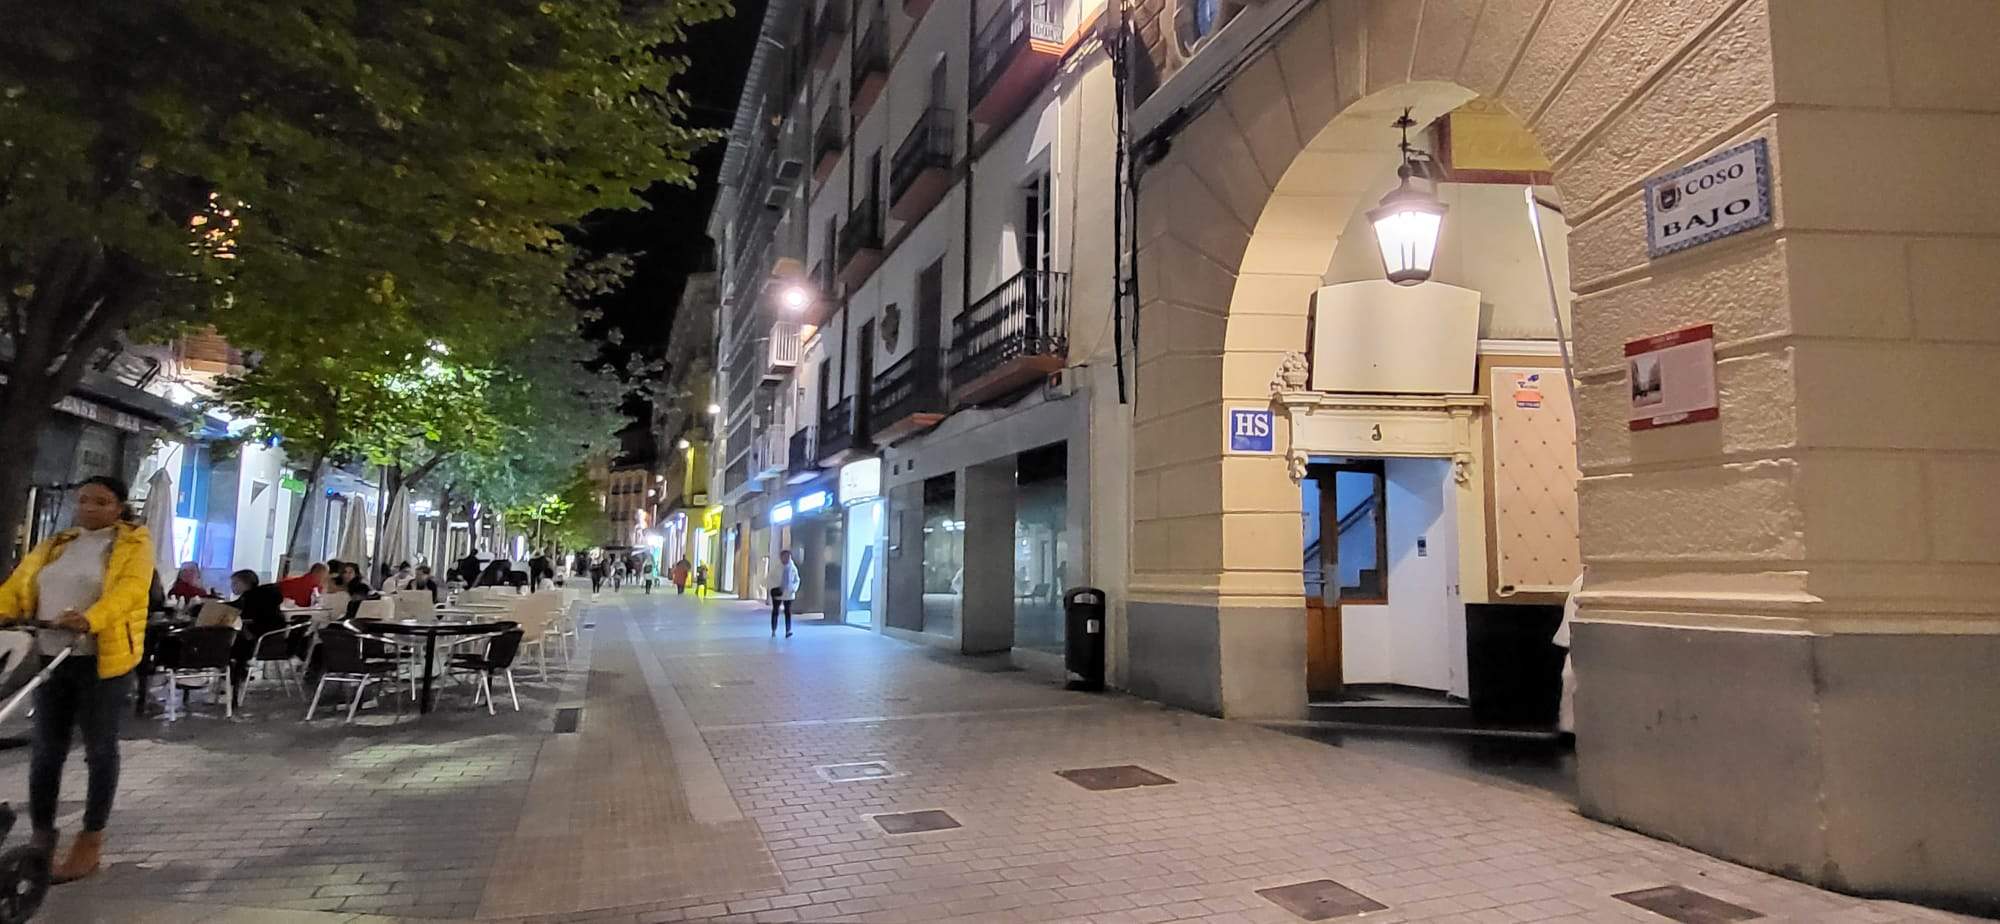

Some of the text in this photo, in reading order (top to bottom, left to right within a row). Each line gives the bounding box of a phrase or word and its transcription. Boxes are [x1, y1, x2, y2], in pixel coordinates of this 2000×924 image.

[1685, 163, 1744, 195] COSO
[1663, 198, 1751, 237] BAJO
[1235, 413, 1269, 437] HS
